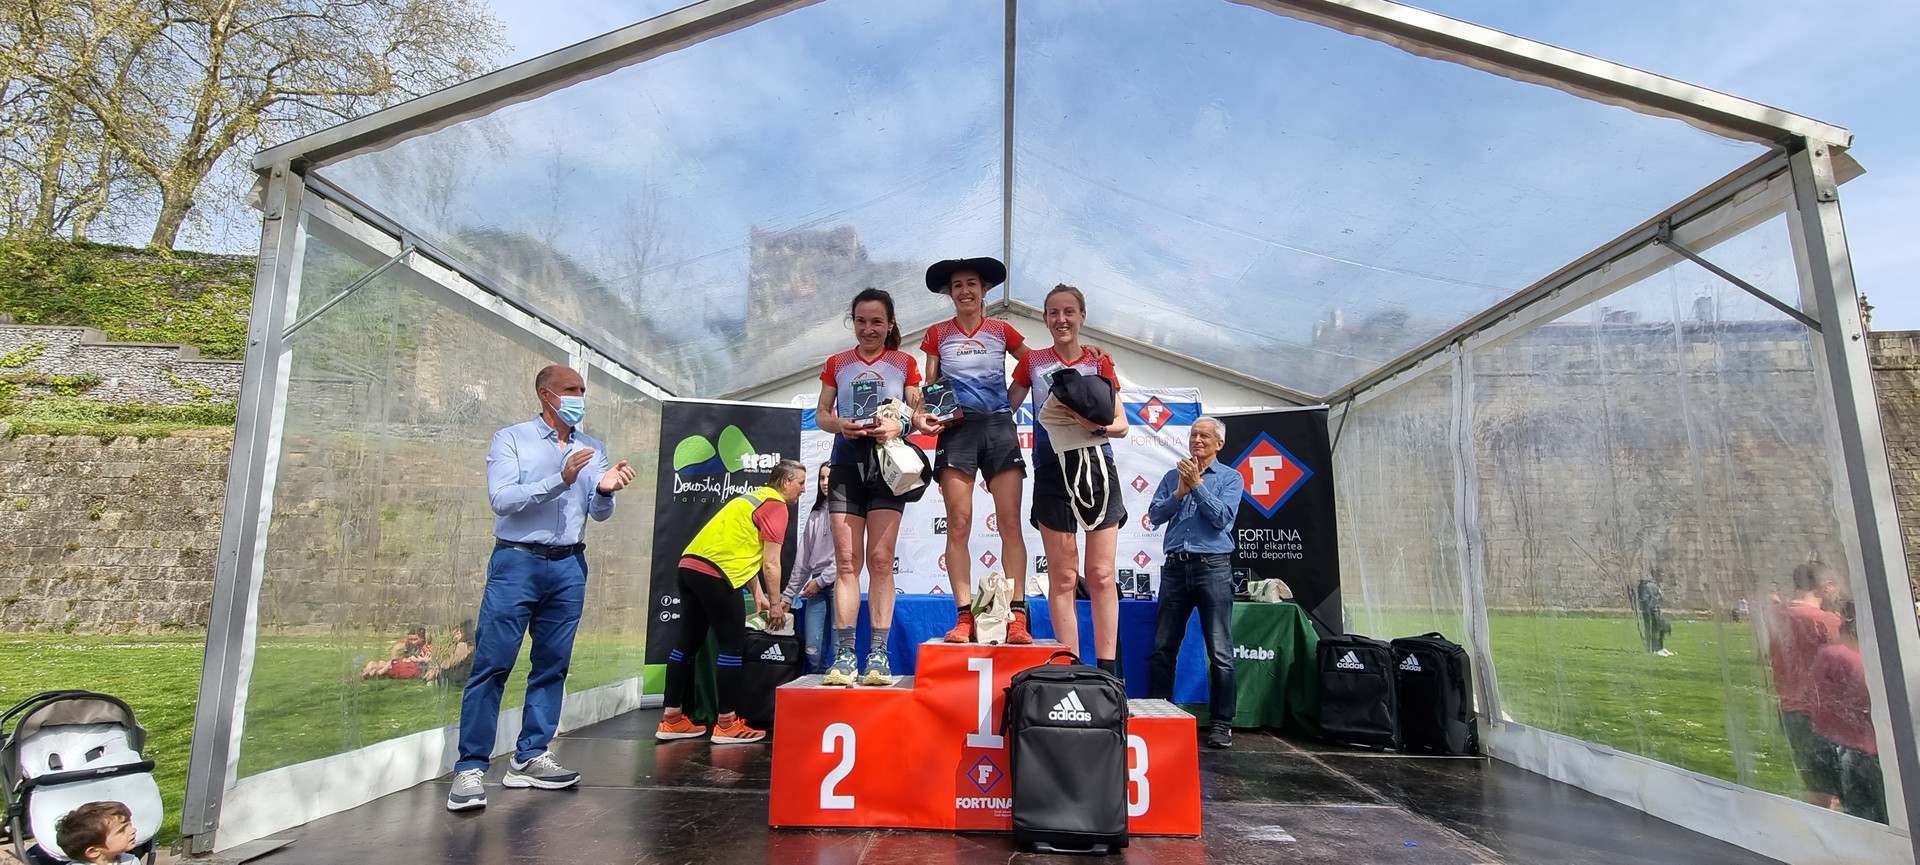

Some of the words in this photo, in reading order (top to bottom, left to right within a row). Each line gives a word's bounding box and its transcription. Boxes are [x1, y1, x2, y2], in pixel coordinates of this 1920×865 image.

[1147, 405, 1163, 424] F
[1131, 435, 1183, 446] FORTUNA
[740, 452, 780, 469] trail
[1248, 455, 1283, 496] F
[1238, 529, 1302, 542] FORTUNA
[1238, 542, 1258, 550] kirol
[1264, 541, 1302, 550] elkartea
[1239, 550, 1258, 558] club
[1261, 551, 1303, 560] deportivo
[760, 654, 786, 662] adidas
[1336, 662, 1365, 670] adidas
[1399, 663, 1422, 672] adidas
[967, 657, 1004, 749] 1
[1048, 709, 1092, 722] adidas
[820, 722, 856, 810] 2
[978, 765, 993, 784] F
[956, 797, 1012, 810] FORTUNA
